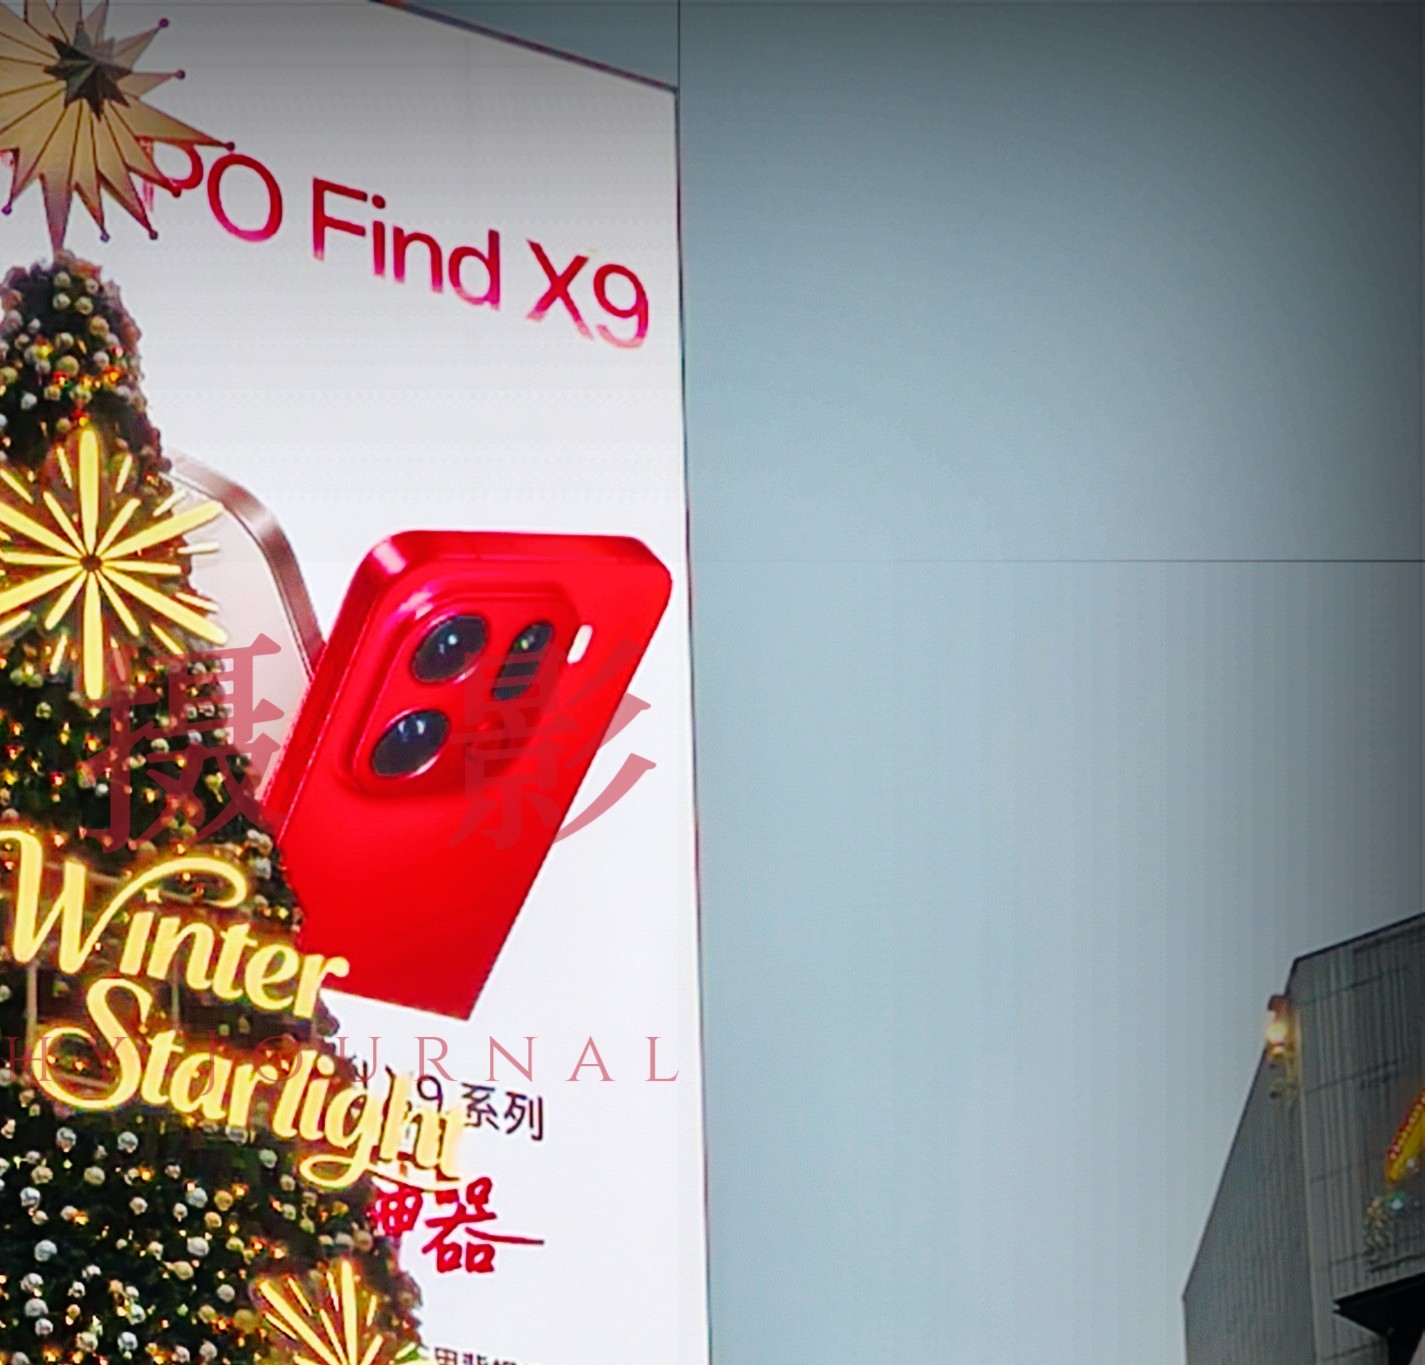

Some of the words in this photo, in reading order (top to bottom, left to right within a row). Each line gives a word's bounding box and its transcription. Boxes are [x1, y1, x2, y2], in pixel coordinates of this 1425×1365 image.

[312, 177, 501, 311] Find
[525, 240, 651, 350] X9
[32, 977, 464, 1190] Starlight
